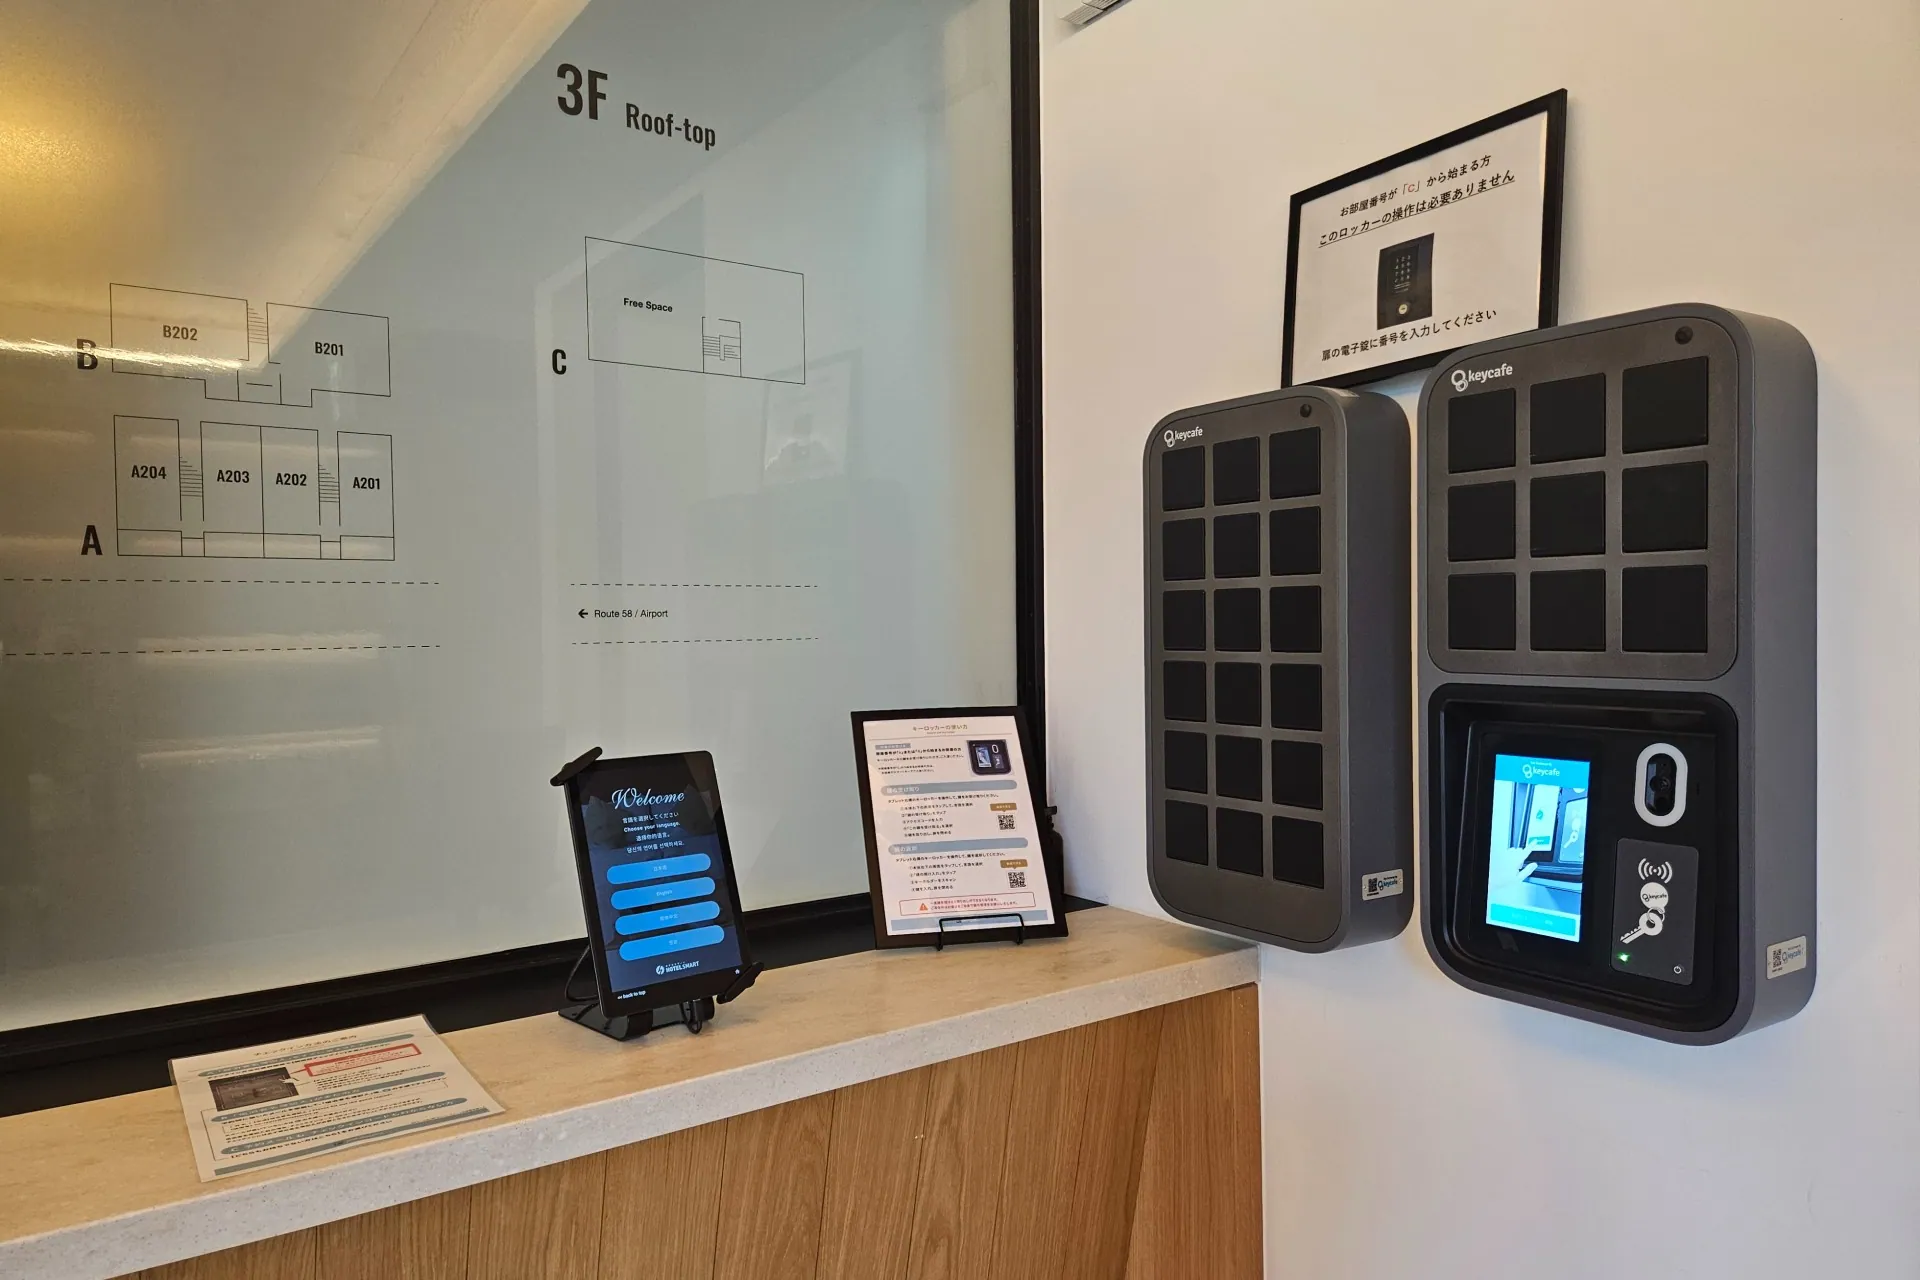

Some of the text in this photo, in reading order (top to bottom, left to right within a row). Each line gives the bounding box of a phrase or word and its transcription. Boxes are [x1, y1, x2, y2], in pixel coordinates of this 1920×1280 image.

[556, 63, 716, 151] 3F Roof-top
[1318, 169, 1516, 247] このロッカーの操作は必要ありません
[623, 297, 673, 312] Free Space
[162, 324, 198, 341] B202
[1321, 309, 1498, 362] 扉の電子錠に番号を入力してください
[76, 338, 99, 370] B
[314, 341, 344, 357] B201
[551, 348, 567, 375] C
[1468, 362, 1513, 384] keycafe
[1174, 426, 1203, 442] keycafe
[130, 464, 167, 480] A204
[216, 469, 250, 484] A203
[275, 473, 307, 487] A202
[352, 476, 381, 490] A201
[80, 524, 103, 556] A
[594, 609, 620, 618] Route
[621, 609, 633, 618] 58
[640, 609, 669, 619] Airport
[1532, 766, 1561, 777] keycafe
[611, 787, 685, 810] Welcome
[644, 824, 655, 832] your
[656, 821, 681, 829] language.
